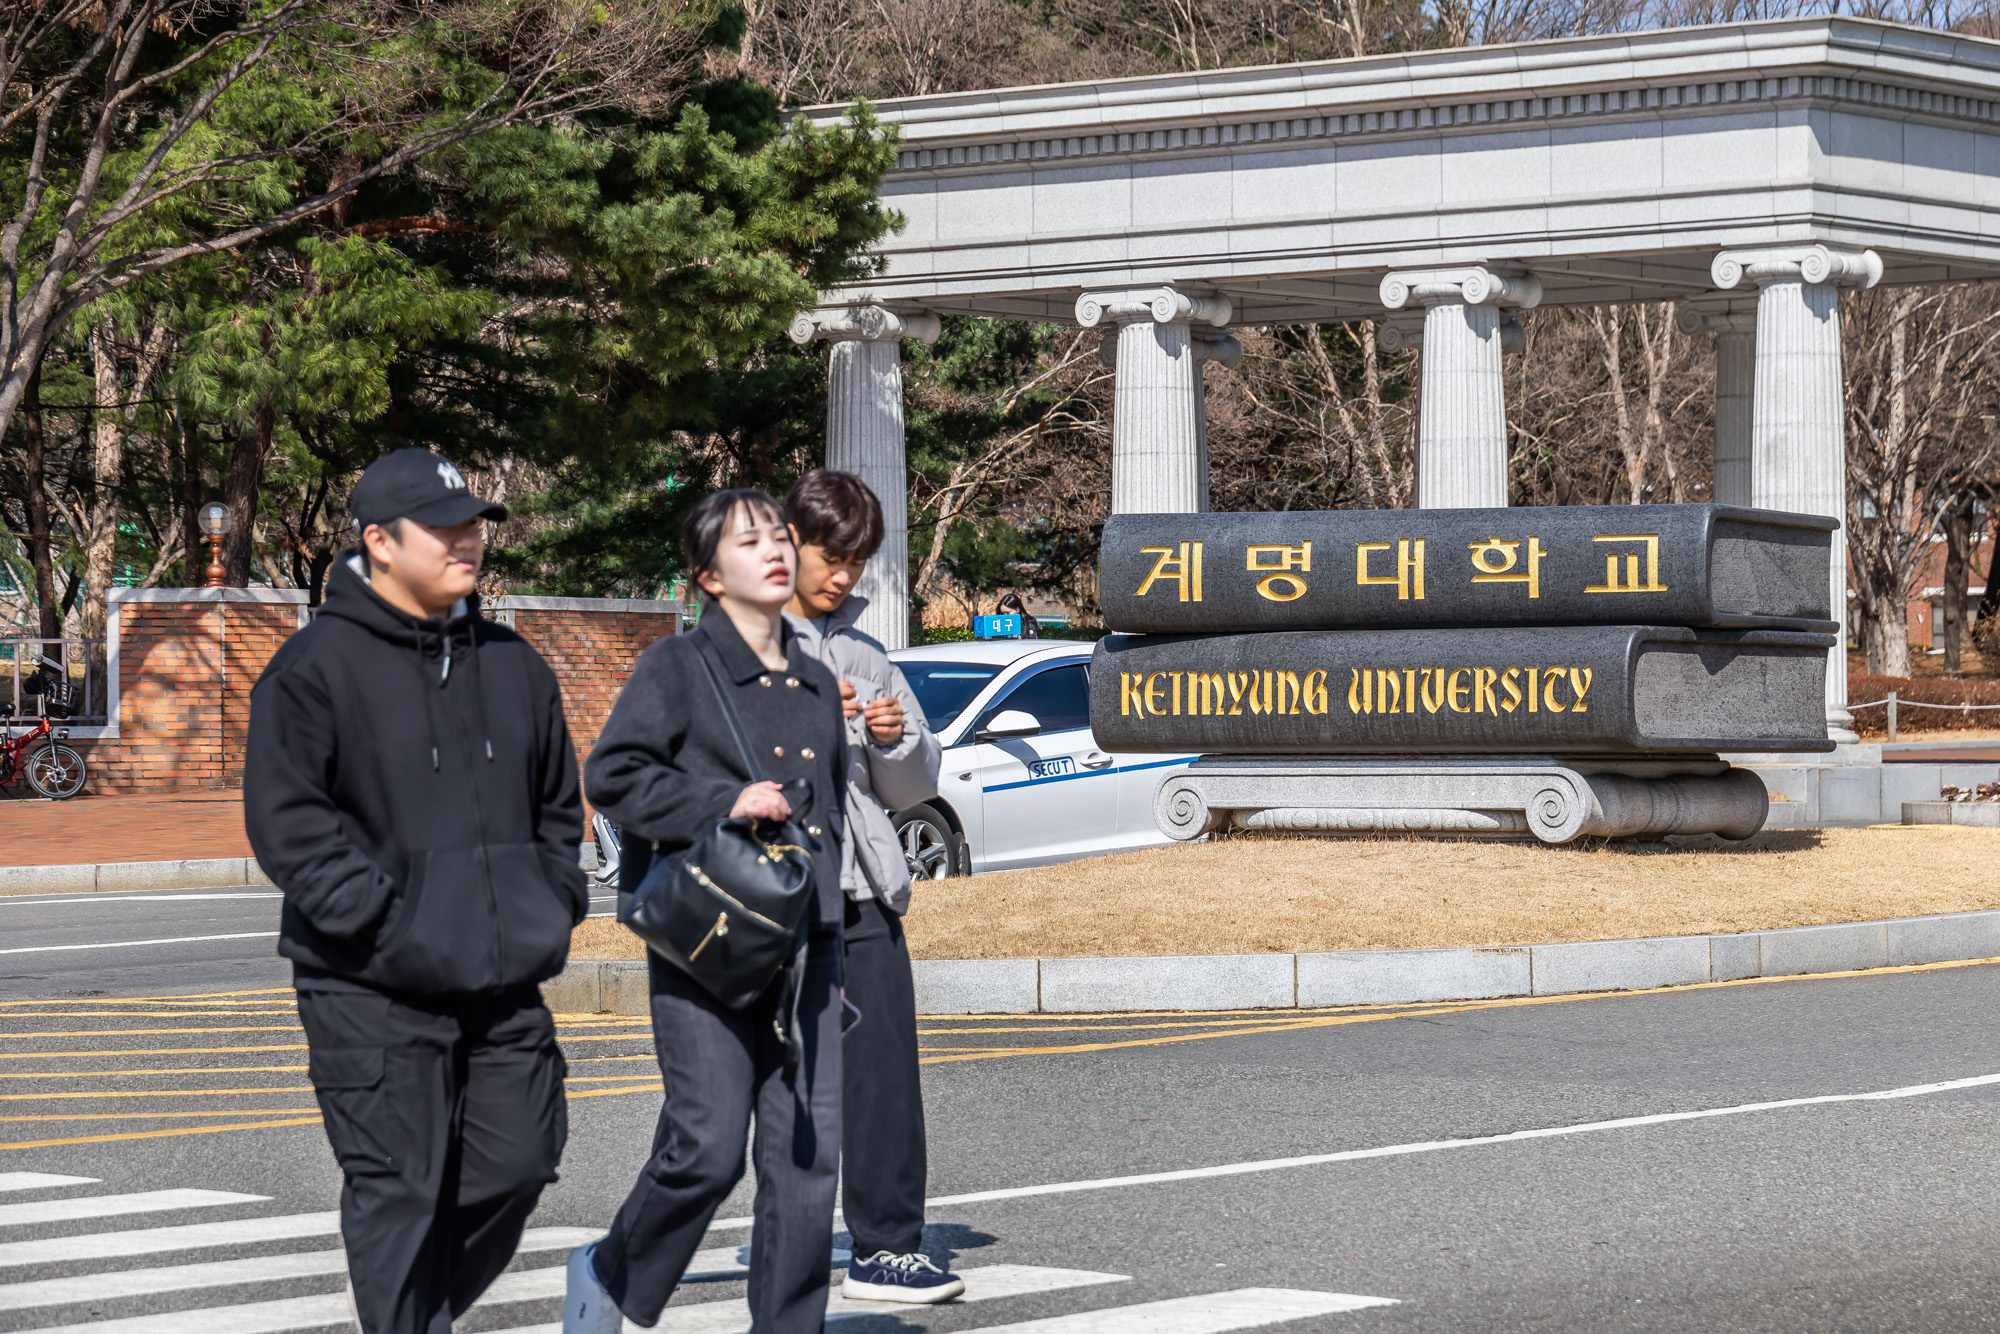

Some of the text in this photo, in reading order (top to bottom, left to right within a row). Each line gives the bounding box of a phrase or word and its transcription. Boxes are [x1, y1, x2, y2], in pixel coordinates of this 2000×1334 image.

[1133, 535, 1669, 602] 계명대학교
[992, 618, 1013, 632] 대구
[1120, 665, 1593, 719] KEIMYUNG UNIVERSITY
